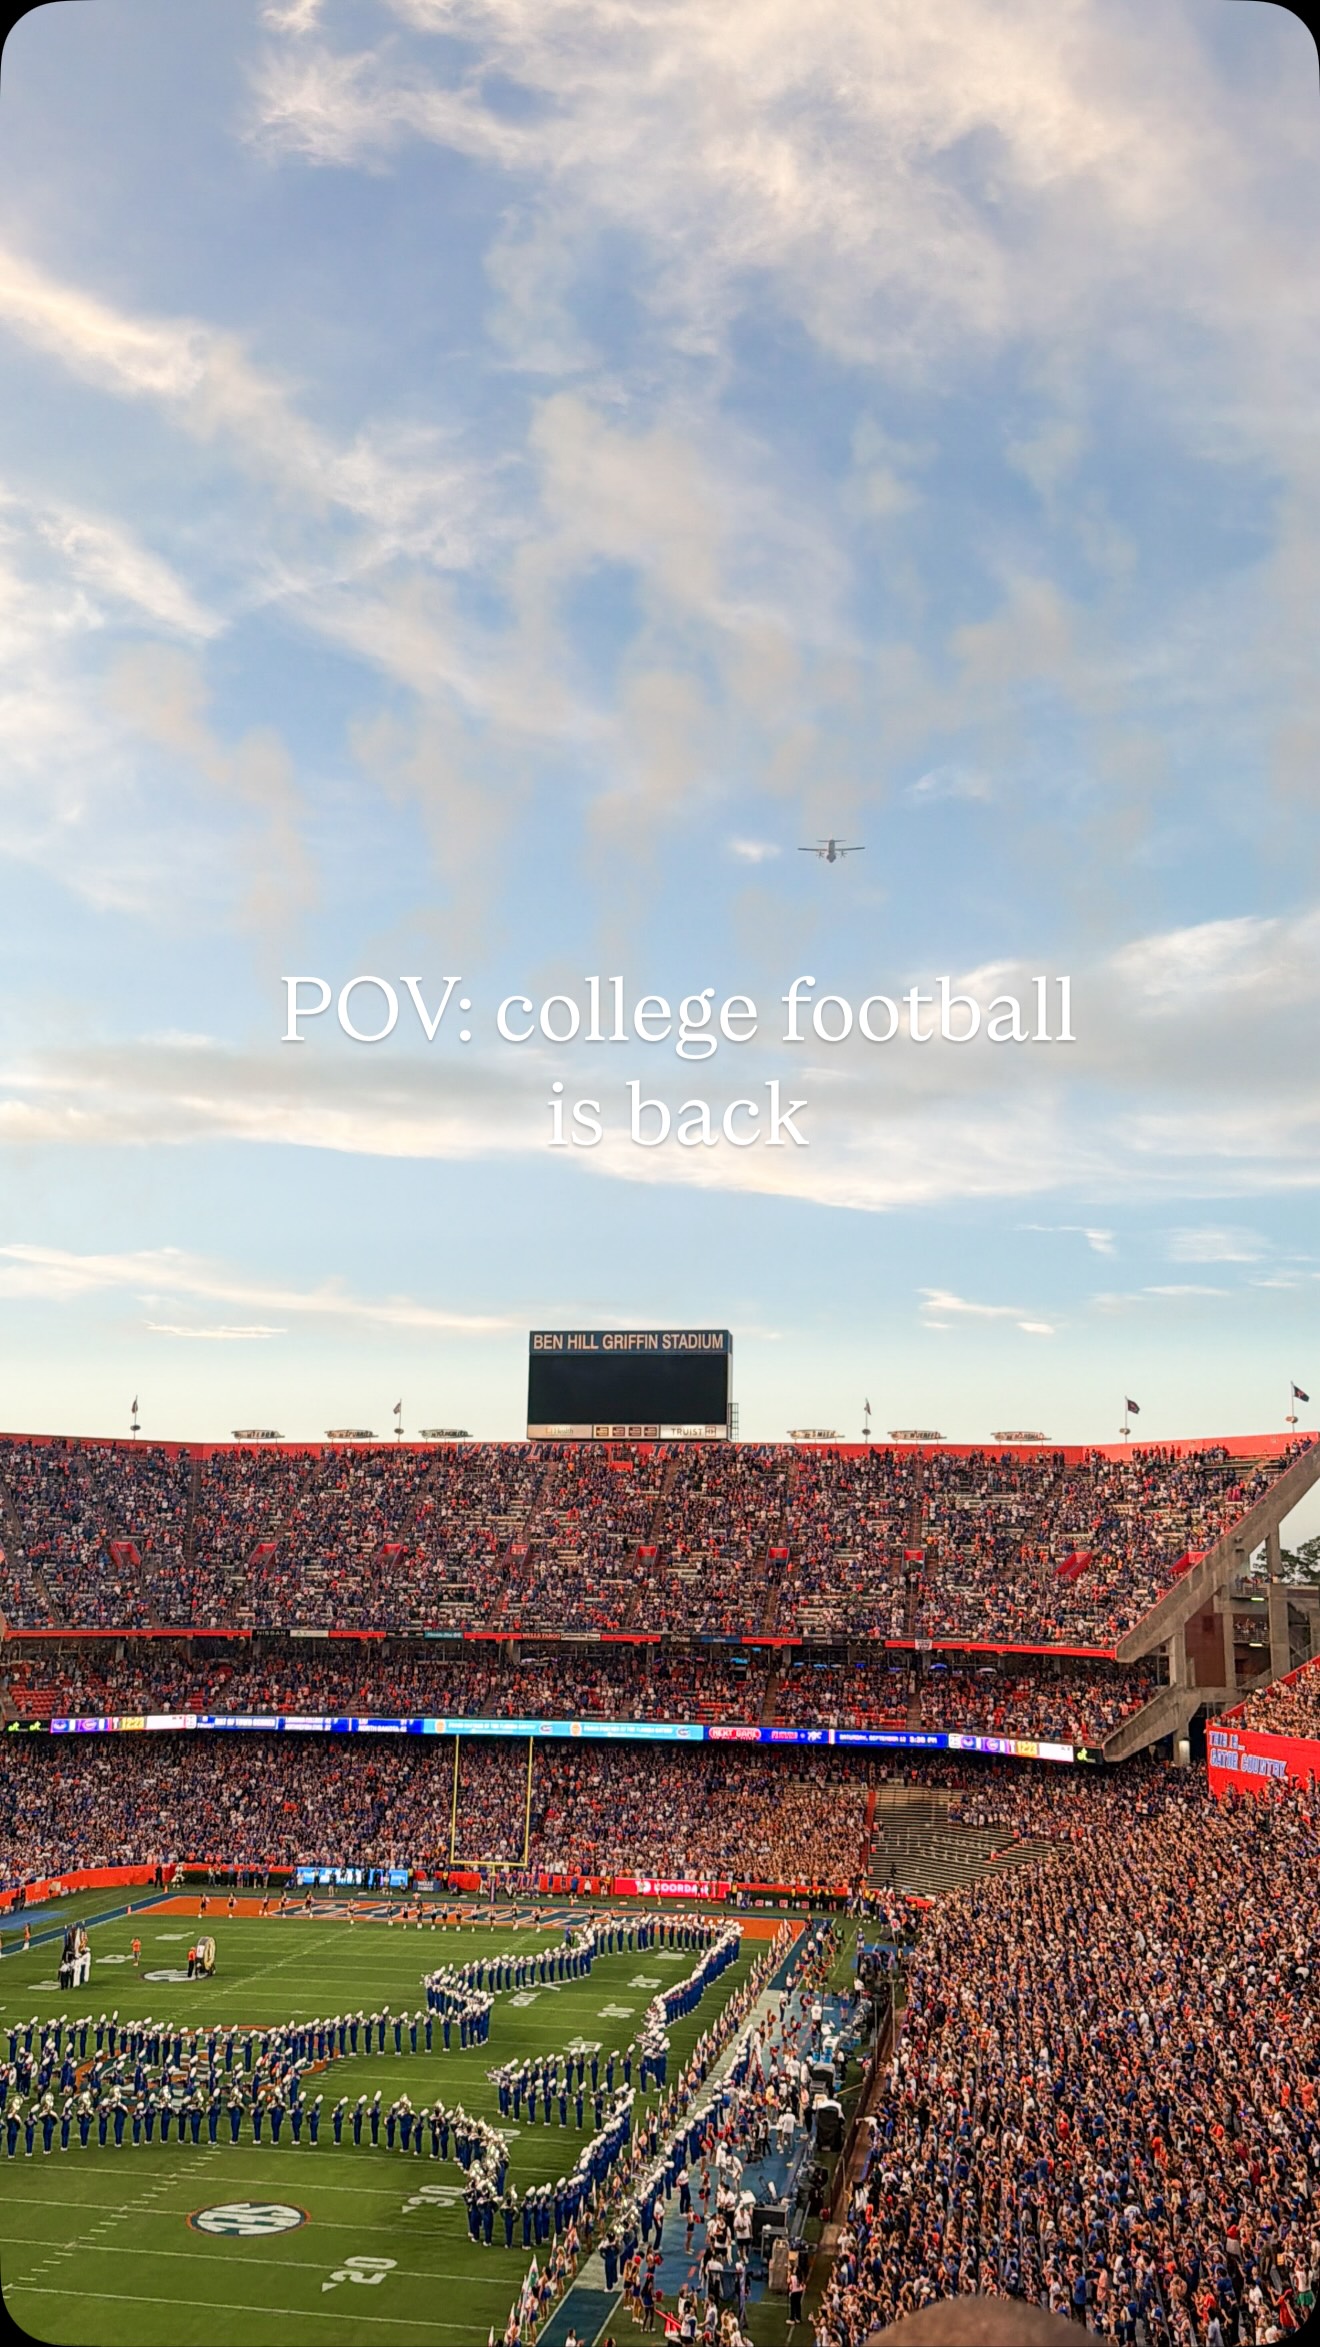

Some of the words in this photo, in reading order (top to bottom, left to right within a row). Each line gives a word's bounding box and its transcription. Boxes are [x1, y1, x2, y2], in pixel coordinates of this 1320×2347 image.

[533, 1333, 563, 1350] BEN
[567, 1333, 599, 1350] HILL
[602, 1333, 659, 1350] GRIFFIN
[661, 1333, 724, 1350] STADIUM
[670, 1427, 703, 1437] TRUIST
[712, 1728, 734, 1739] NEXT
[1208, 1730, 1228, 1748] THIS
[1209, 1747, 1239, 1771] GATOR
[1240, 1752, 1288, 1779] COUNTRY
[407, 2184, 467, 2208] 30
[328, 2254, 399, 2286] 20
